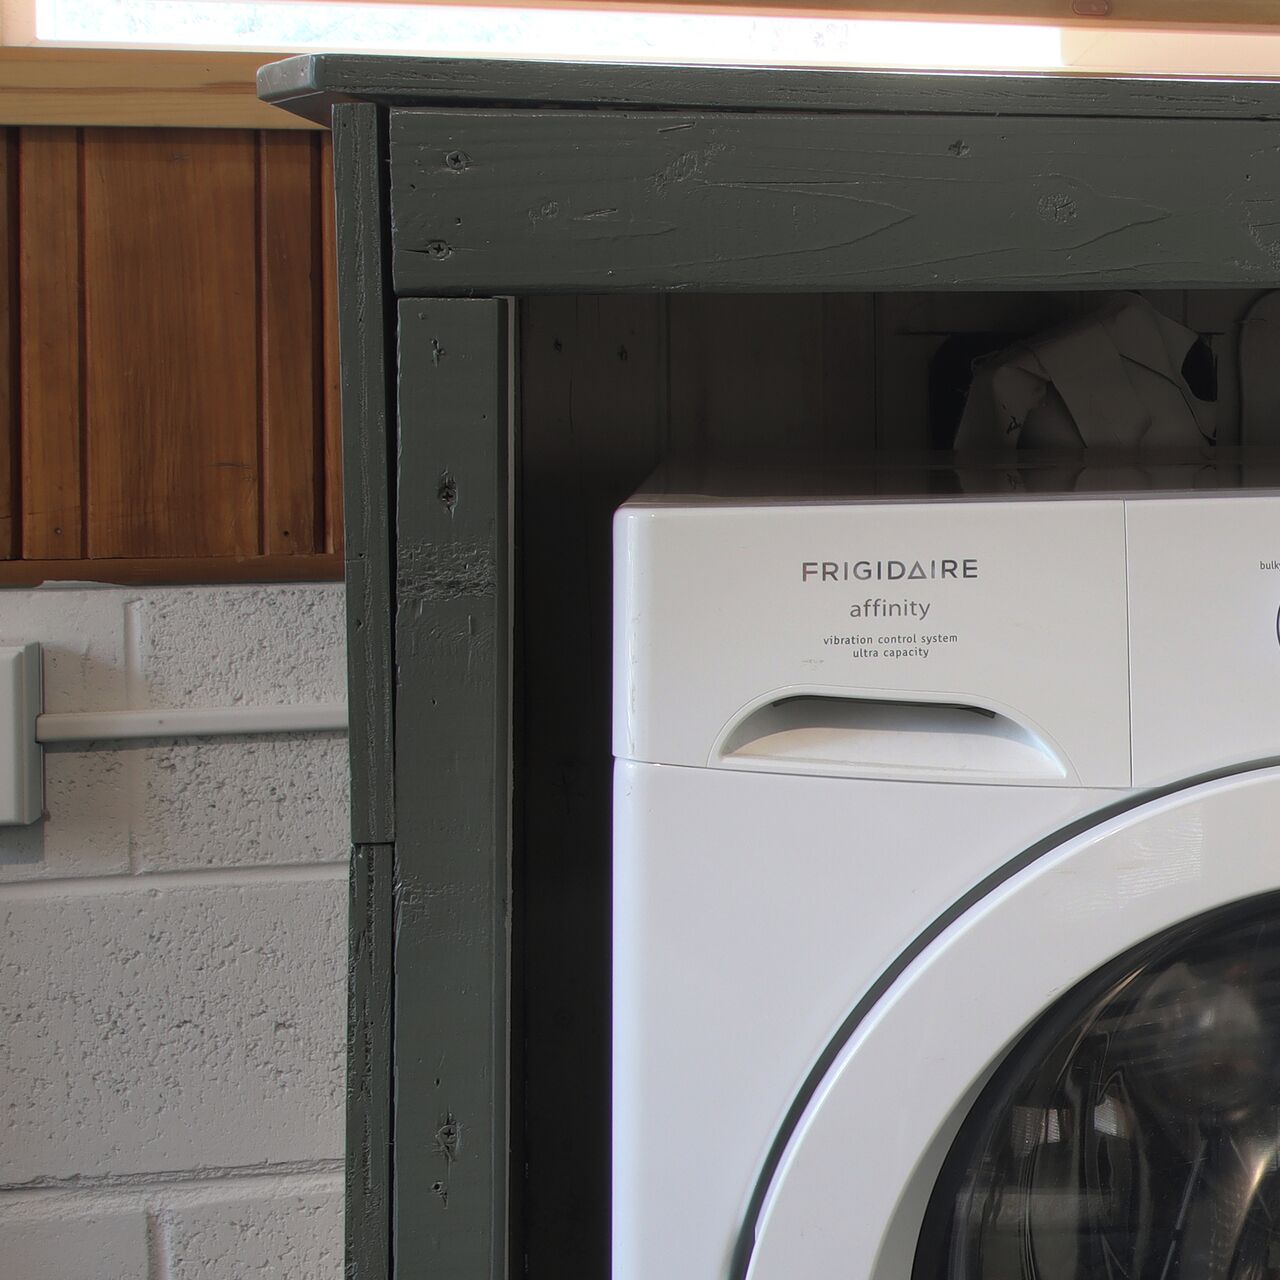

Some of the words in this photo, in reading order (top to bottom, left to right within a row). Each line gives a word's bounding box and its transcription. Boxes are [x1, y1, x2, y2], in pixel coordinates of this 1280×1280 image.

[802, 559, 978, 582] FRIGIDAIRE
[850, 598, 930, 621] affinity
[823, 635, 873, 646] vibration
[878, 634, 916, 644] control
[921, 633, 958, 645] system
[853, 648, 879, 658] ultra
[883, 647, 929, 659] capacity
